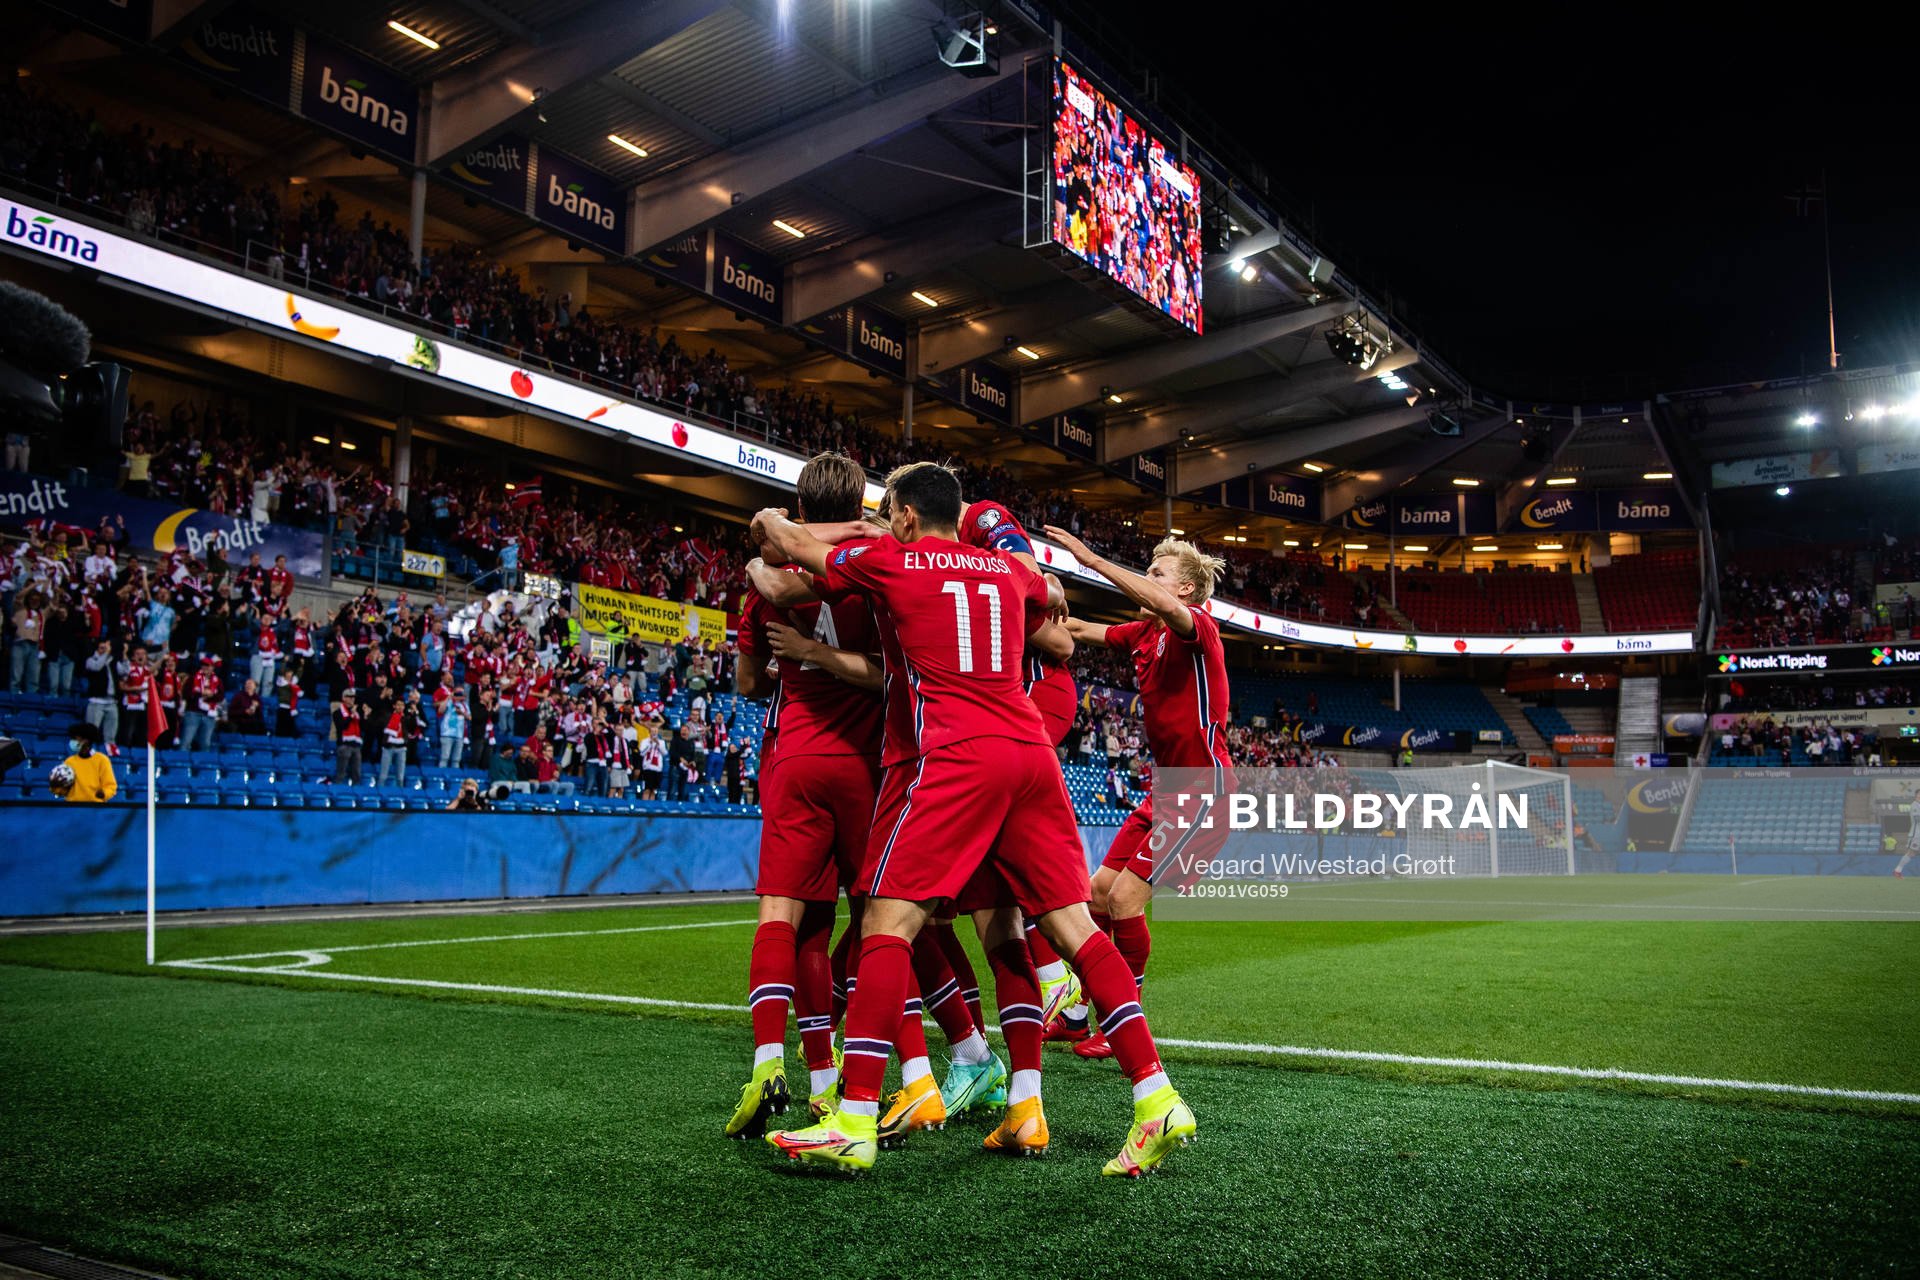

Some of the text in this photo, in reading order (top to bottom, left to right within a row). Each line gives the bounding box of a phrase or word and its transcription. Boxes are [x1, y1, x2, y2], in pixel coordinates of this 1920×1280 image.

[1361, 502, 1387, 519] Bendit
[1533, 498, 1574, 521] Bendit
[185, 518, 265, 554] Bendit
[407, 557, 427, 572] 227
[585, 592, 681, 622] HUMAN RIGHTS FOR
[585, 610, 680, 637] MIGRNT WORKERS
[941, 580, 1002, 672] 11
[1739, 653, 1828, 670] Norsk Tipping
[1301, 723, 1325, 741] Bendit
[1352, 727, 1379, 745] Bendit
[1411, 729, 1440, 747] Bendit
